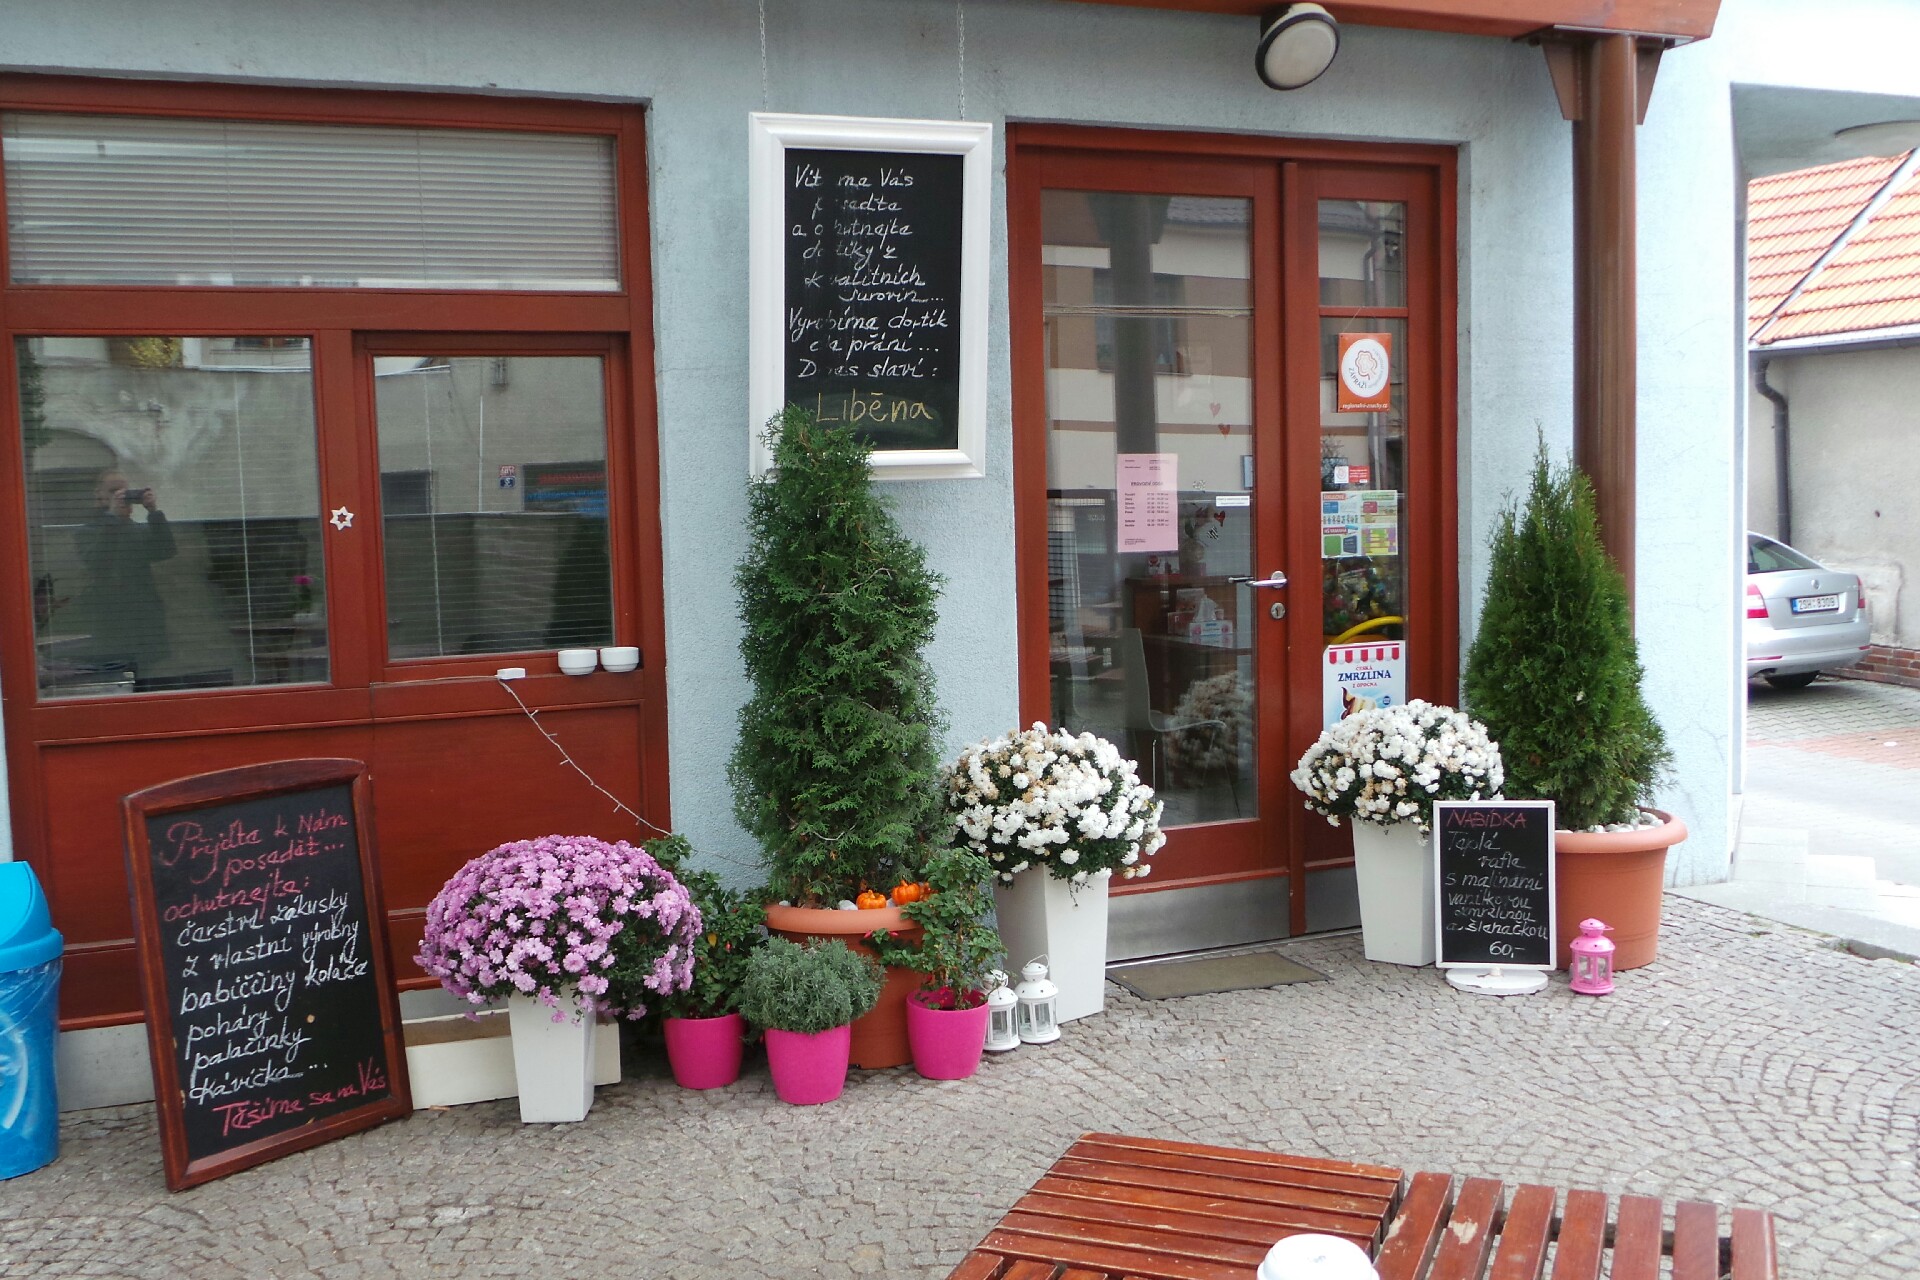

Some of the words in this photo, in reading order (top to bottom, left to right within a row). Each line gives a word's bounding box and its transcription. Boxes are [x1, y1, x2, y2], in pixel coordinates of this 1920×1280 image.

[880, 167, 914, 188] Vás
[791, 222, 807, 236] a
[883, 245, 898, 259] z
[887, 306, 949, 332] dortík
[1337, 669, 1392, 682] ZMRZLINA
[272, 813, 289, 838] k
[297, 808, 349, 834] Nám
[1445, 808, 1527, 829] NABÍDKA
[1447, 830, 1501, 857] Teplá
[1461, 869, 1544, 891] malinami
[269, 887, 349, 926] zákusky
[1464, 918, 1549, 940] šlehačkou
[209, 924, 293, 971] vlastní
[179, 969, 297, 1015] babiččiny
[304, 953, 369, 987] koláče
[184, 1002, 274, 1061] poháry
[189, 1015, 312, 1090] palačinky
[337, 1083, 359, 1099] na
[357, 1056, 387, 1097] Vás
